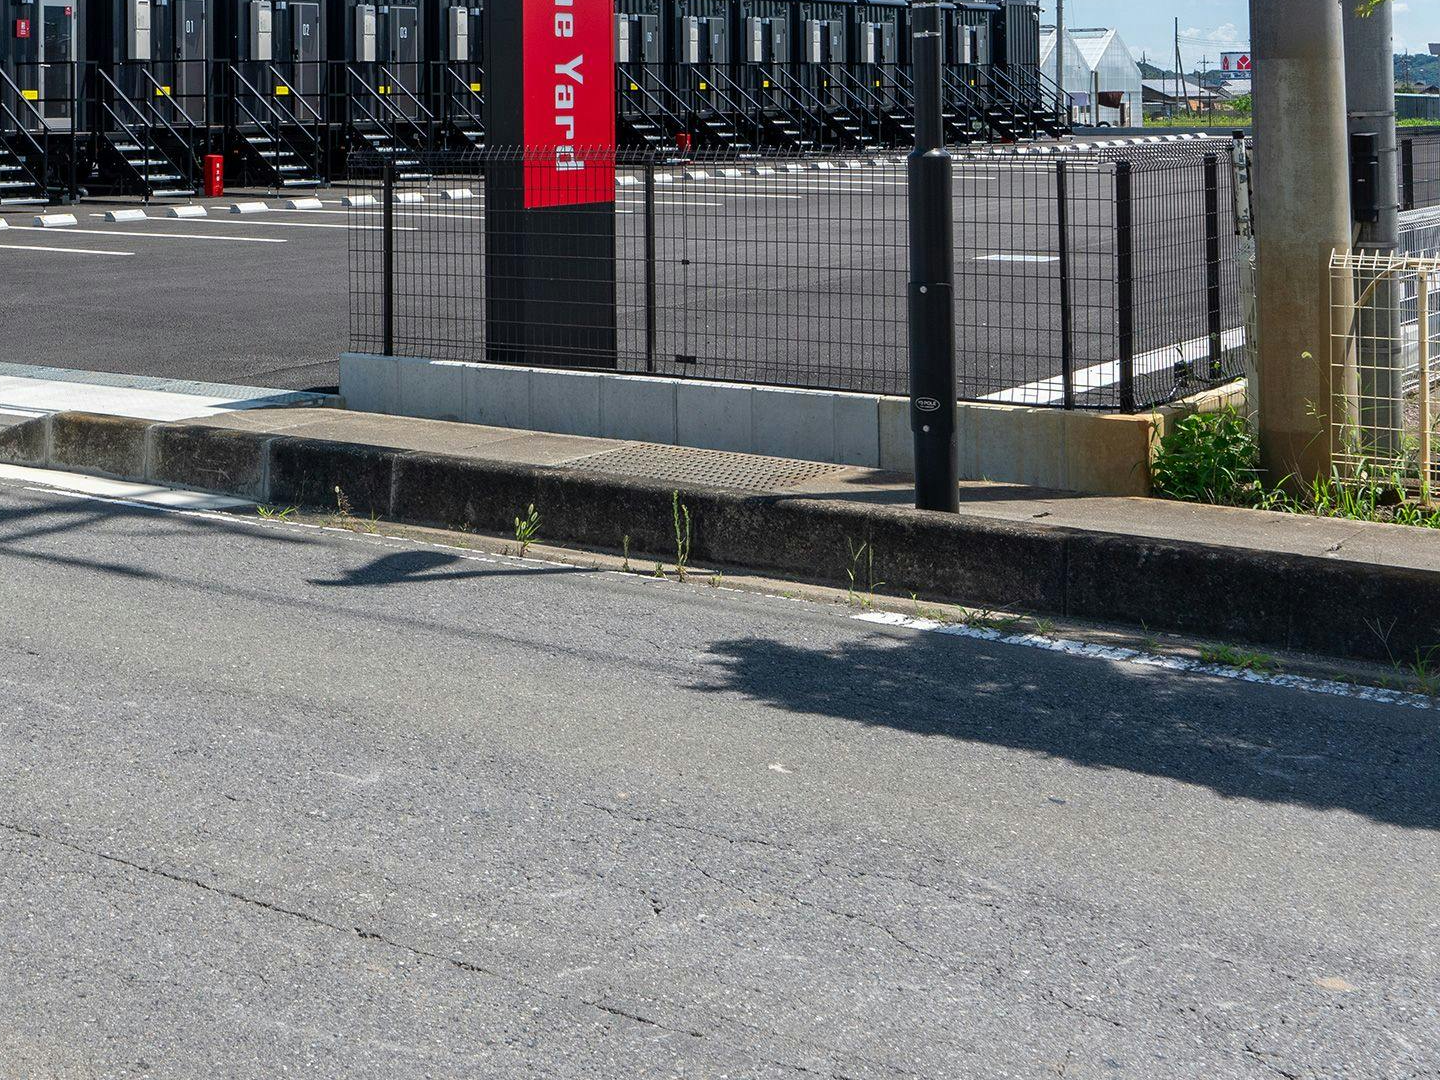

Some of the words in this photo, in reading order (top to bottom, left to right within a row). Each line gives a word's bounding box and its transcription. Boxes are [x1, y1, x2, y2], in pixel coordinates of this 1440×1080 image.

[185, 20, 194, 33] 01
[302, 23, 310, 36] 02
[554, 55, 584, 172] Yard
